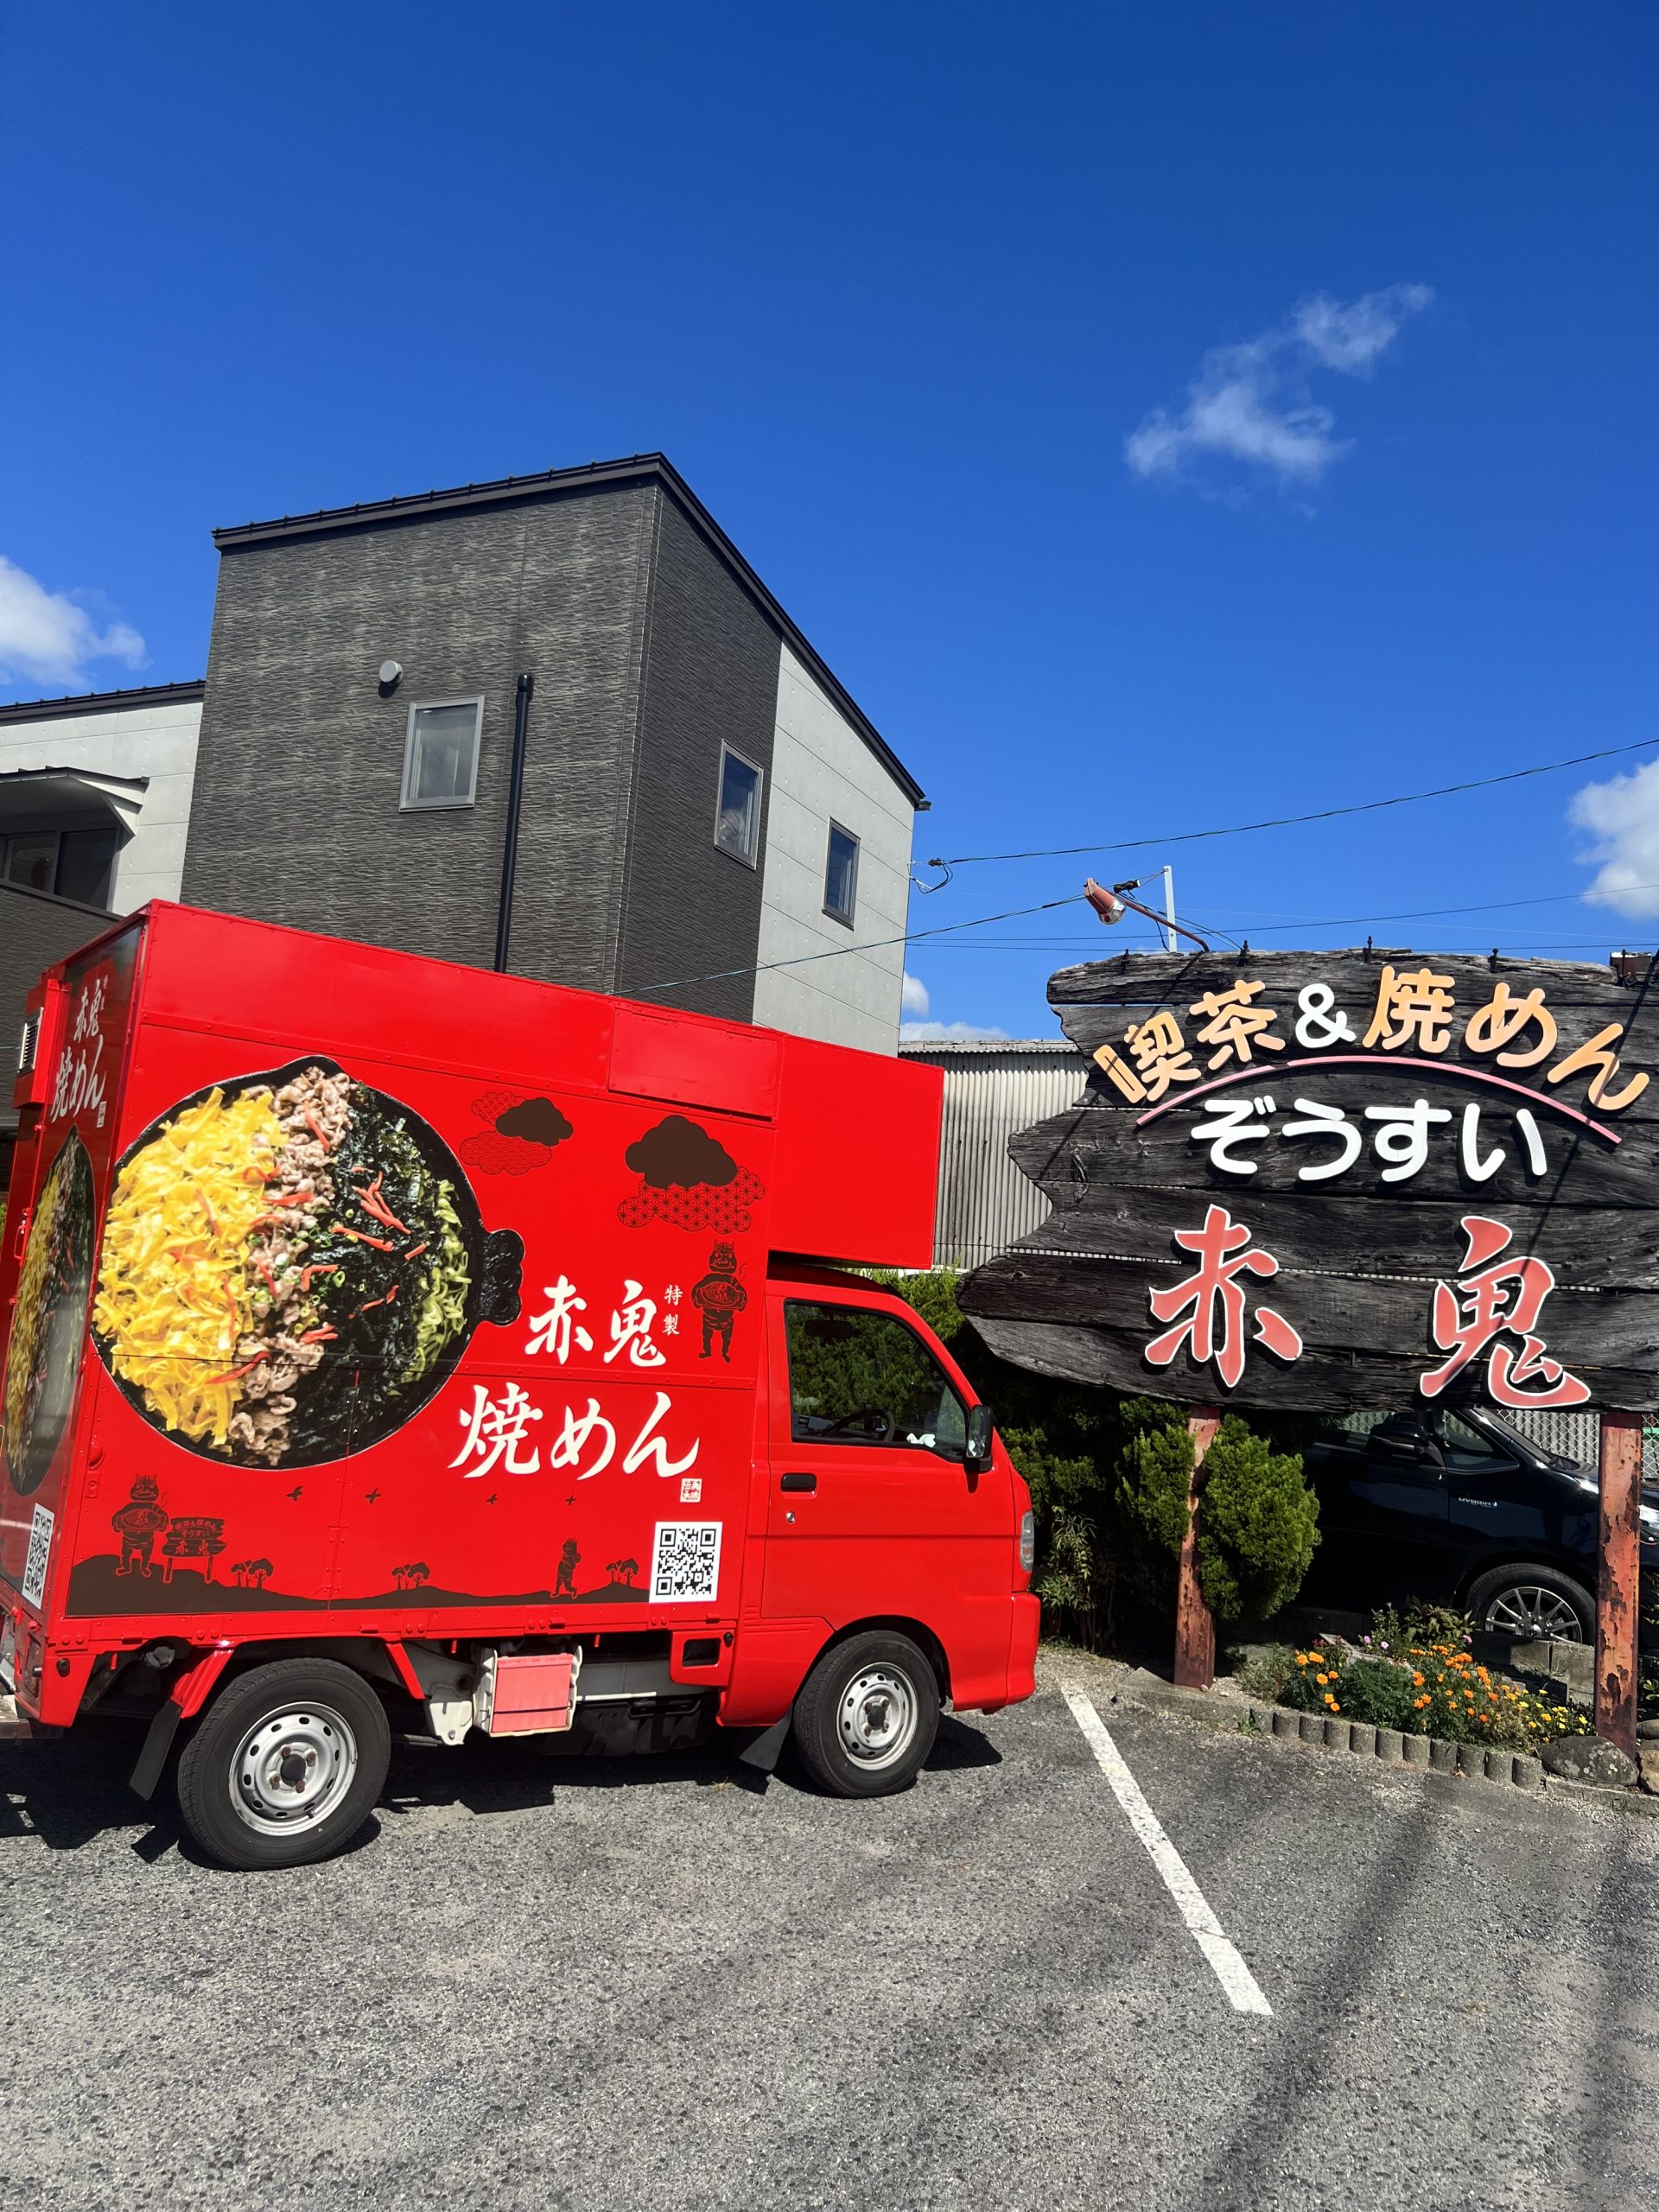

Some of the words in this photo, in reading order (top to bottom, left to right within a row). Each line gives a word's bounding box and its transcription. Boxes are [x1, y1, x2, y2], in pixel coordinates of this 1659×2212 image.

[50, 1033, 107, 1123] 焼めん
[1092, 965, 1650, 1111] 喫茶&焼めん
[1191, 1094, 1548, 1183] ぞうすい
[524, 1274, 667, 1368] 赤鬼
[662, 1284, 683, 1336] 特製
[1144, 1203, 1592, 1408] 赤鬼
[447, 1382, 700, 1481] 焼めん
